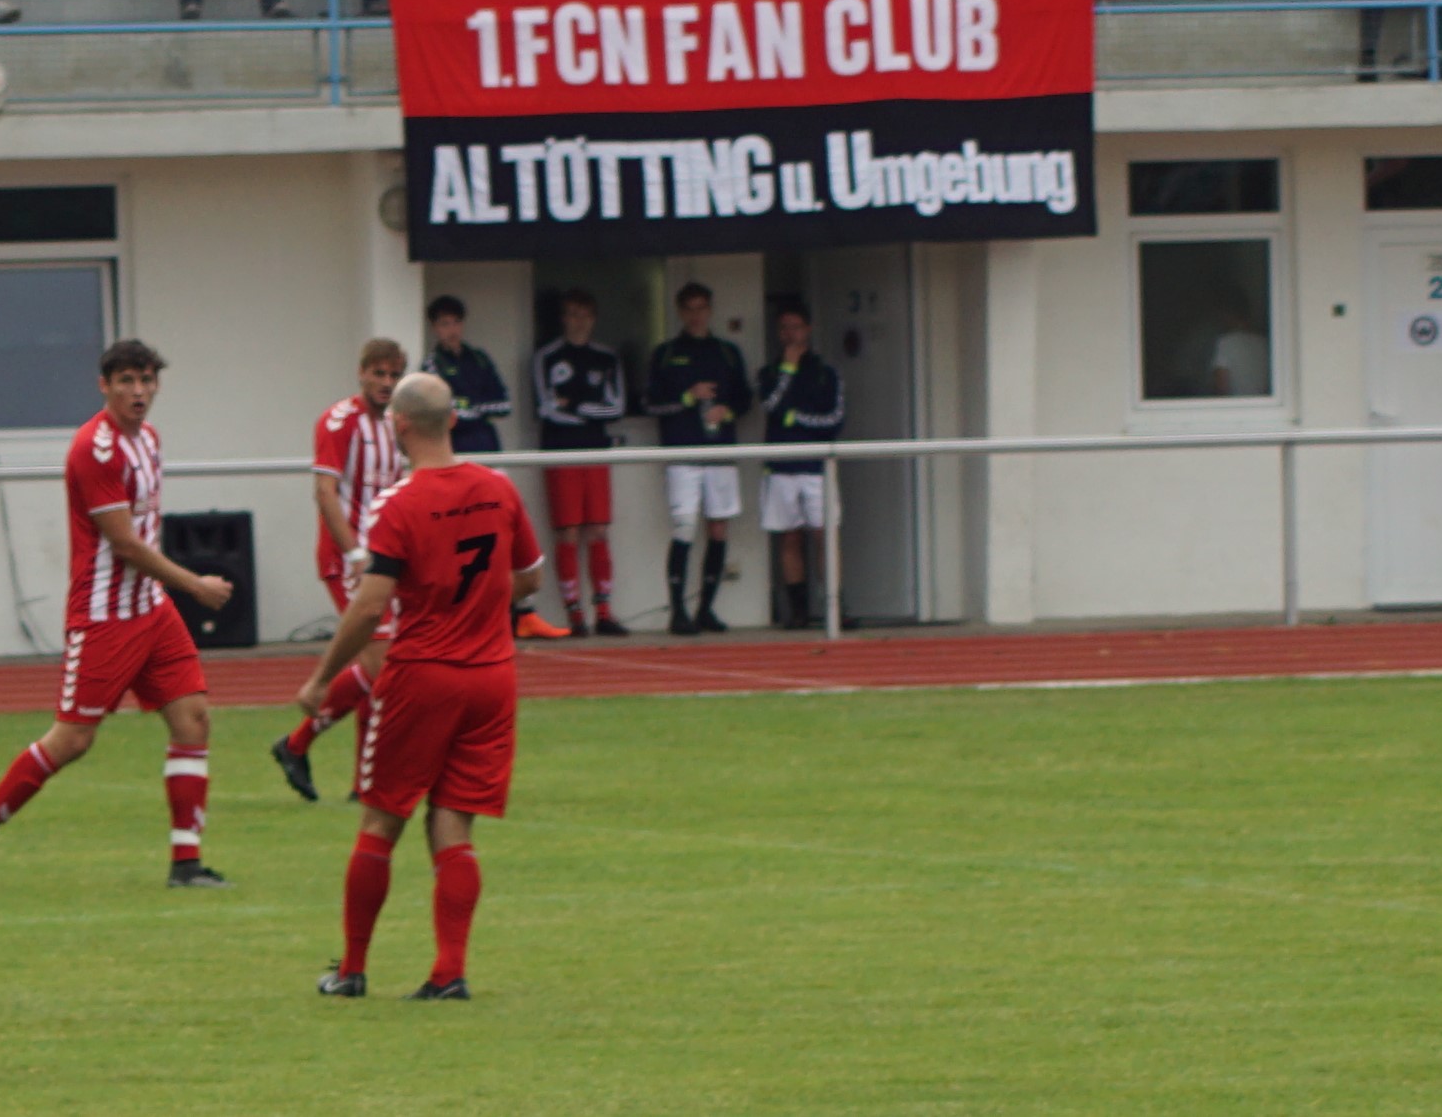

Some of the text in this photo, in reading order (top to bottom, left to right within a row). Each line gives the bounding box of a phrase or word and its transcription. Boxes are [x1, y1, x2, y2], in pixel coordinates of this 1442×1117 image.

[466, 3, 649, 88] 1.FCN
[663, 0, 806, 84] FAN
[430, 130, 1077, 225] ALTÖTTING u. Umgebung
[452, 532, 498, 606] 7
